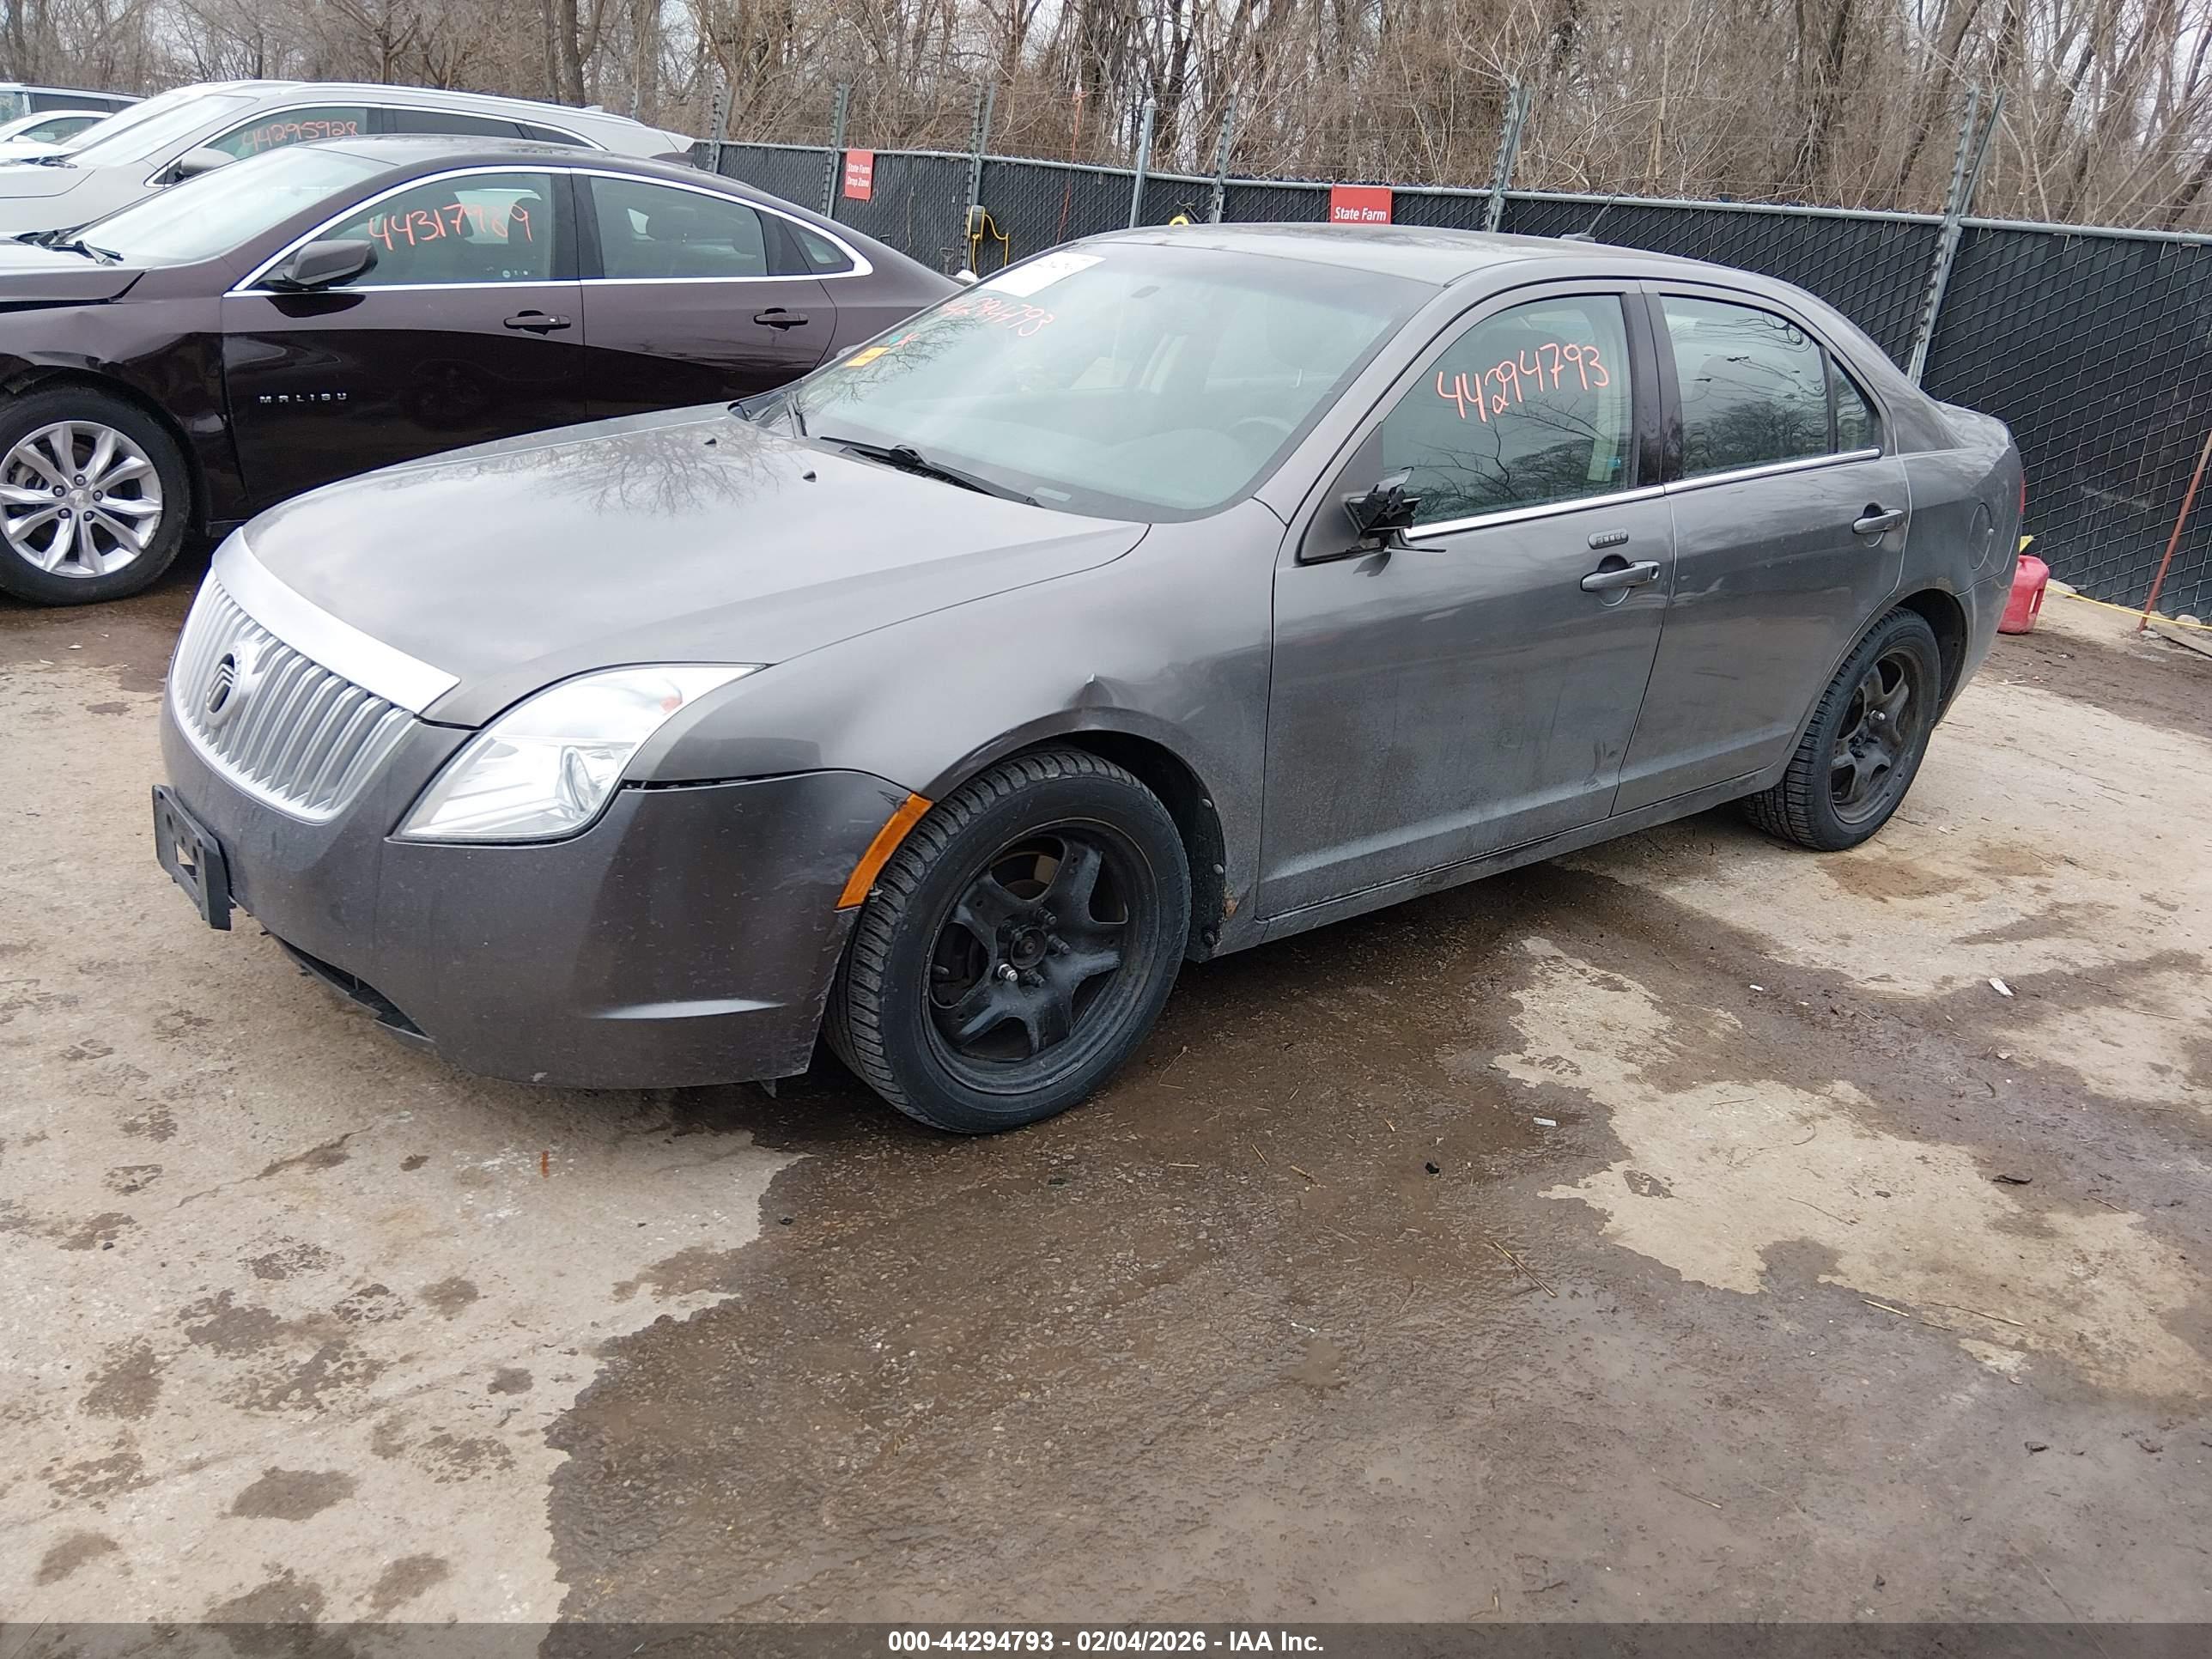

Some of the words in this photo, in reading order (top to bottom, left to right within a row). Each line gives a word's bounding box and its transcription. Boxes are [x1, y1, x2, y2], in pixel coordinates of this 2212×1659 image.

[241, 121, 358, 152] 44295928
[1334, 206, 1359, 221] State
[1361, 207, 1387, 221] Farm
[1437, 343, 1610, 422] 44294793
[259, 392, 347, 404] MALIBU
